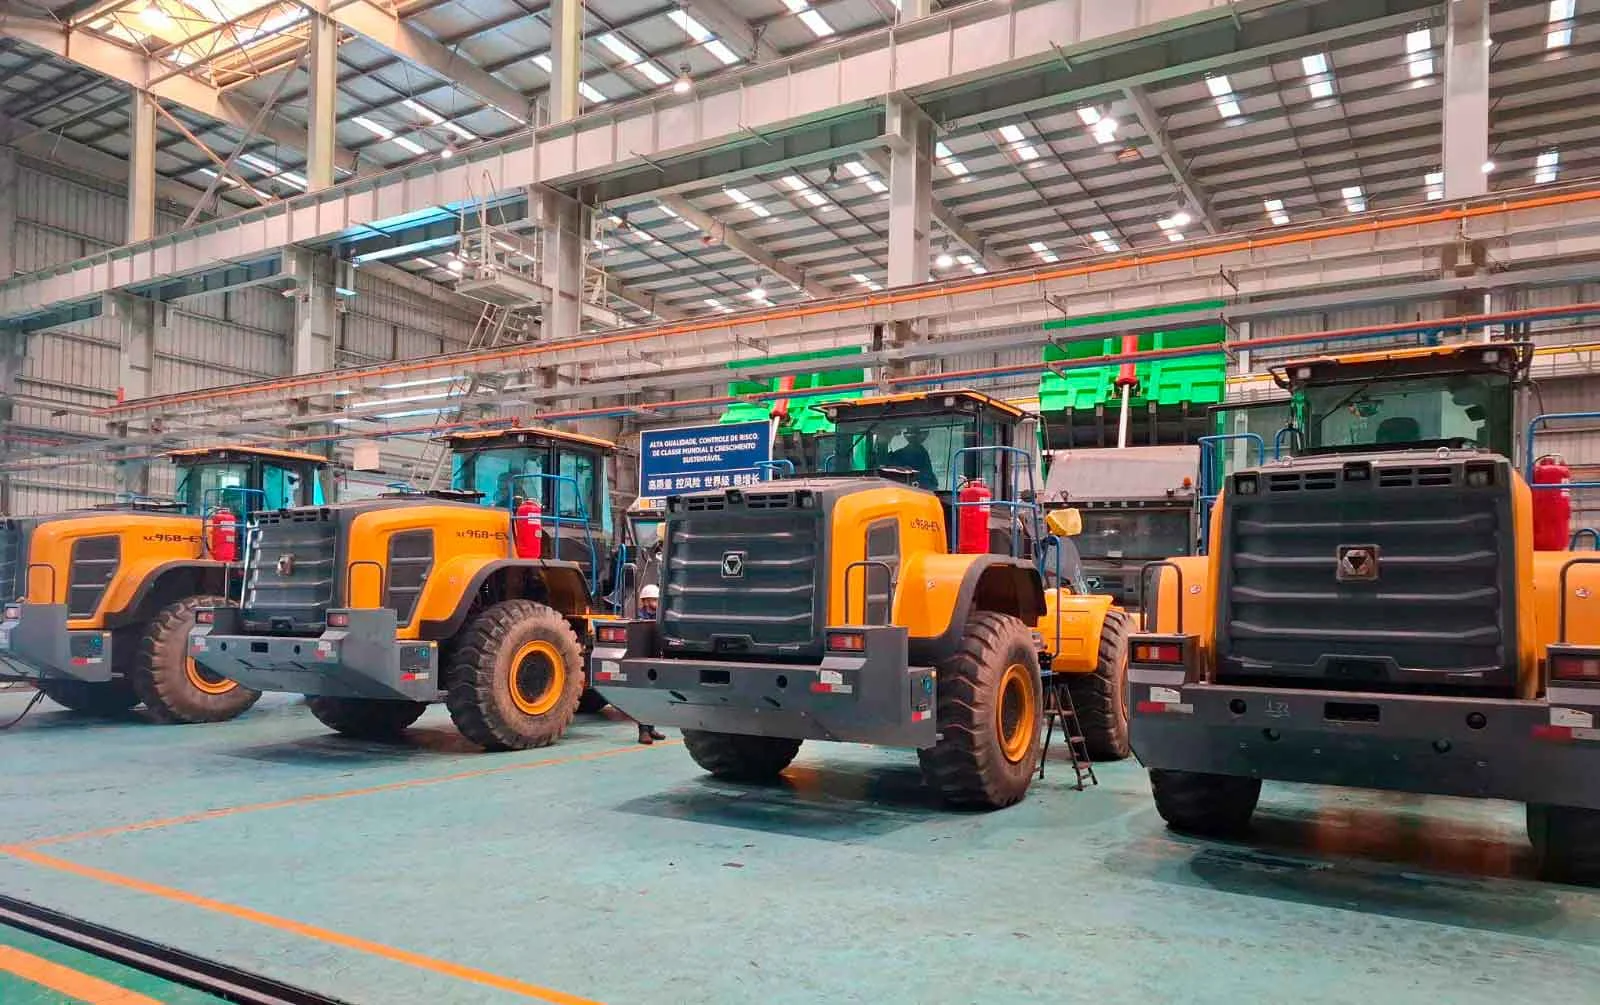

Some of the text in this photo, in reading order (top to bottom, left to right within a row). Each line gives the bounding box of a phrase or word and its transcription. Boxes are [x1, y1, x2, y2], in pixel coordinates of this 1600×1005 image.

[649, 440, 663, 449] ALTA
[699, 435, 730, 444] CONTROLE
[730, 434, 738, 442] DE
[660, 447, 681, 456] CLASSE
[682, 445, 708, 454] MUNDIAL
[714, 442, 756, 452] CRESCIMENTO
